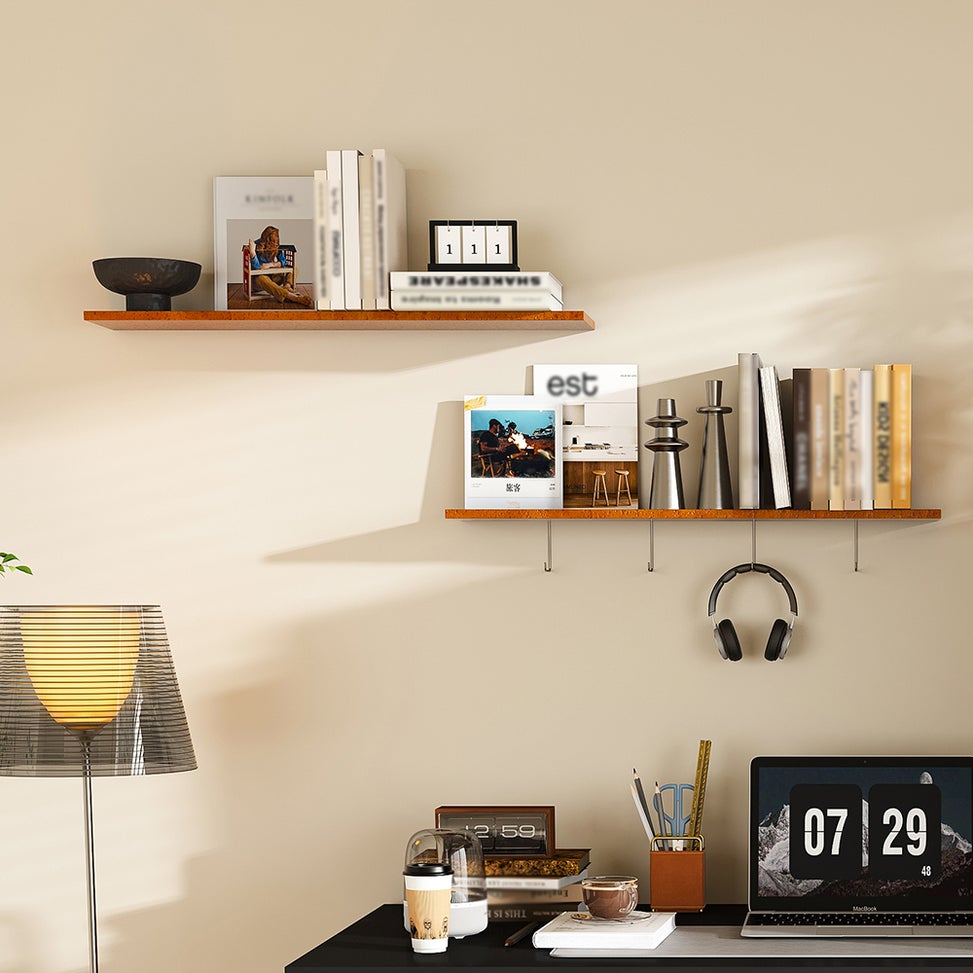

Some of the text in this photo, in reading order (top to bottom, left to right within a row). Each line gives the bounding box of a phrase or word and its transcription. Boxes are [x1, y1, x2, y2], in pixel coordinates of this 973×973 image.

[446, 244, 501, 254] 1 1 1
[409, 275, 541, 286] SHAKESPEARE
[547, 372, 598, 397] est
[500, 825, 535, 838] 59
[804, 807, 927, 856] 07 29
[921, 865, 932, 876] 48
[505, 909, 528, 918] THIS
